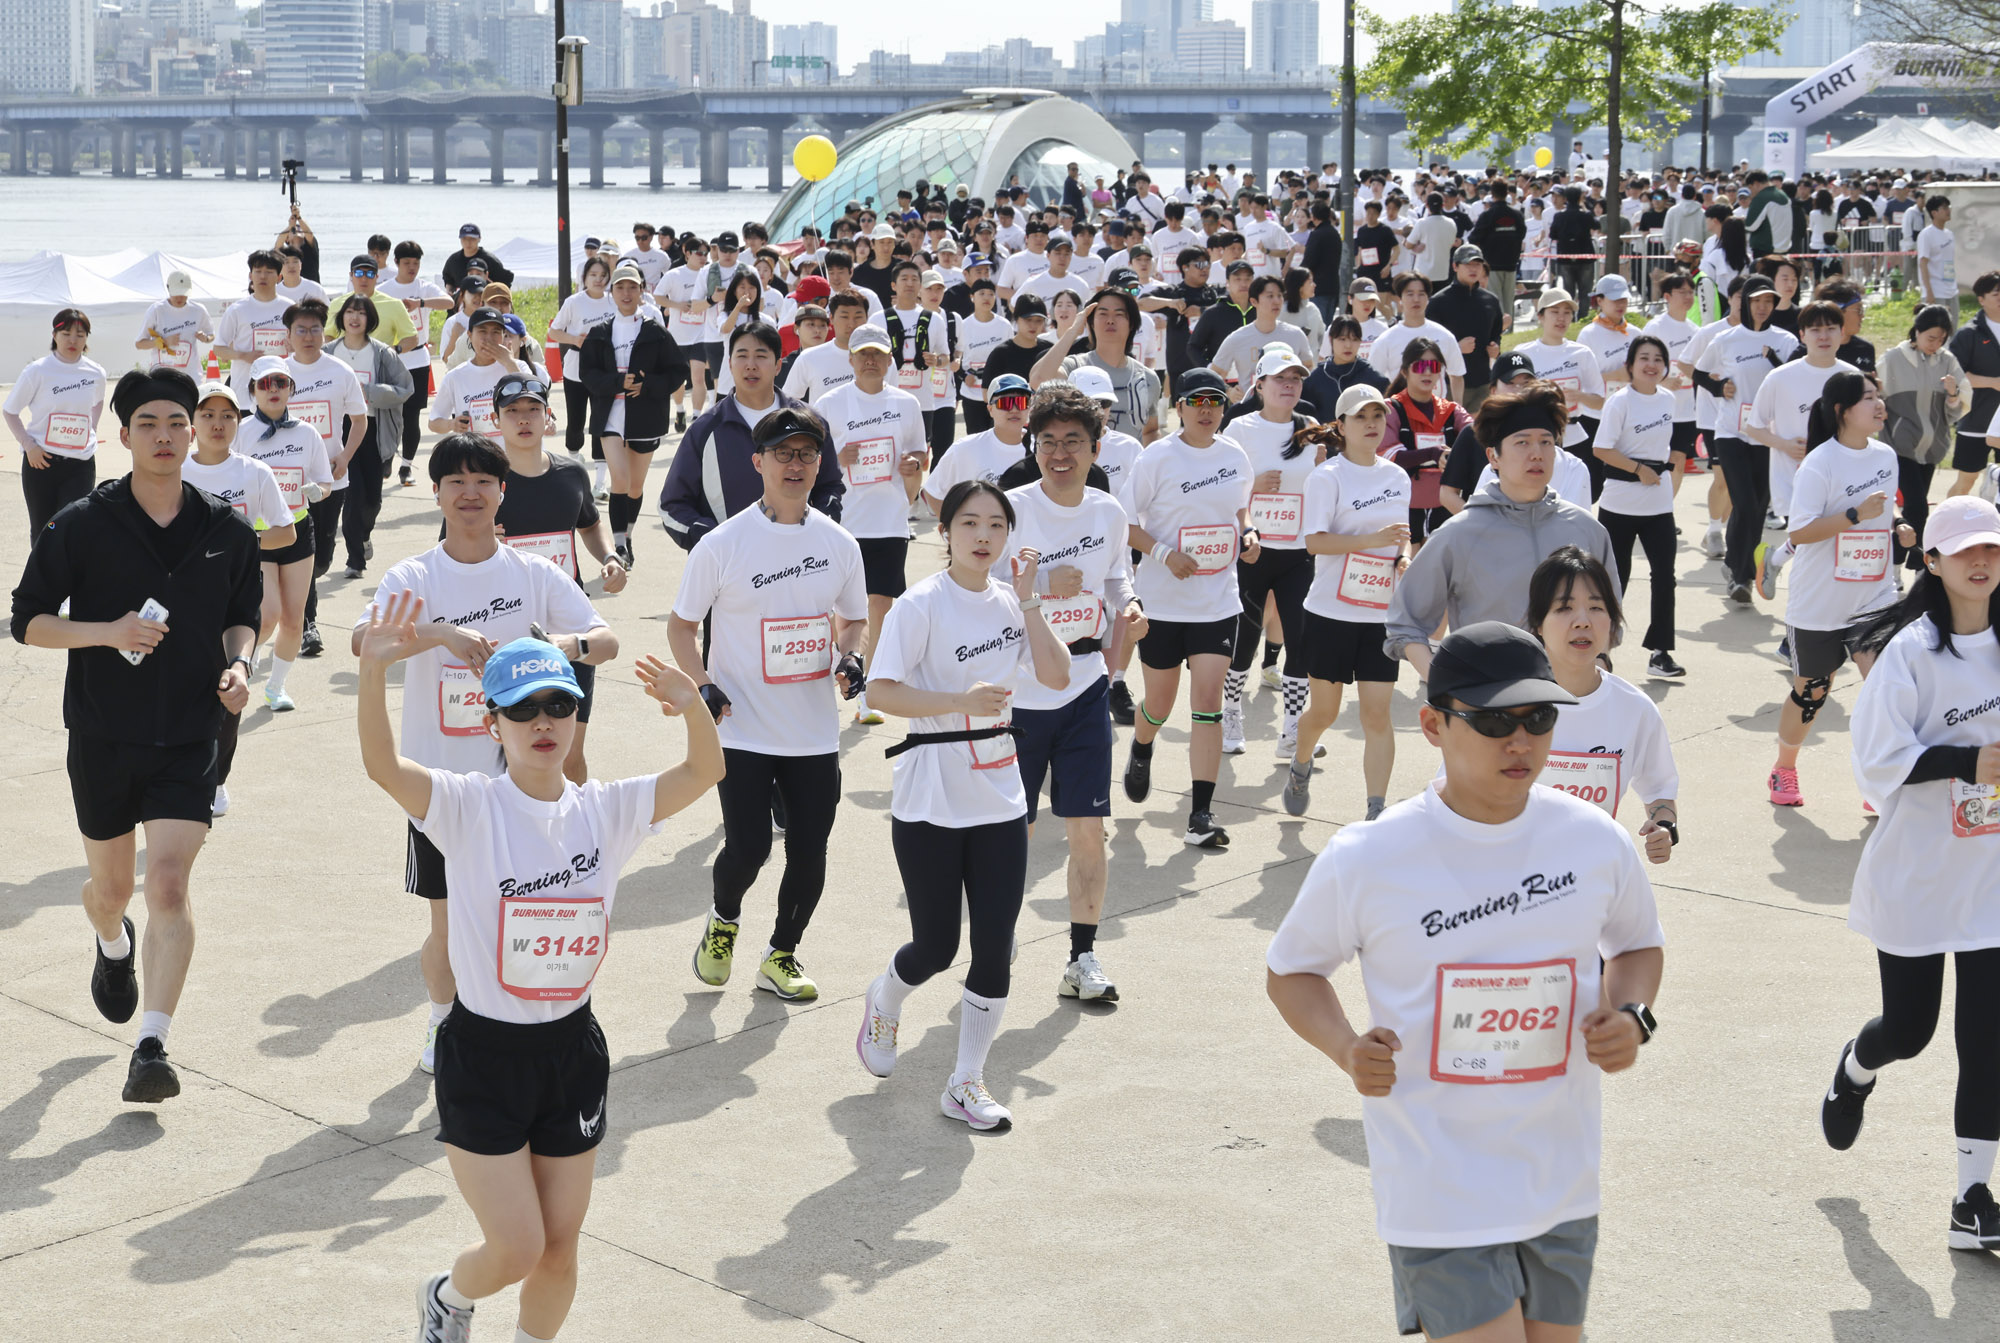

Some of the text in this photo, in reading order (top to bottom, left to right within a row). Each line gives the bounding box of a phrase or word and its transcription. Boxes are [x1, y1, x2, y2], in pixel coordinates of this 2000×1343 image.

[1790, 64, 1856, 114] START
[52, 378, 94, 394] Burning Run
[315, 379, 333, 389] Run
[822, 374, 854, 386] Burning
[847, 411, 902, 431] Burning Run
[1634, 418, 1663, 434] Burning
[60, 426, 84, 436] 3667
[284, 444, 304, 455] Run
[862, 453, 890, 466] 2351
[1102, 464, 1121, 474] Run
[1180, 468, 1238, 494] Burning Run
[1845, 469, 1892, 496] Burning Run
[221, 489, 245, 500] Run
[1352, 489, 1402, 510] Burning Run
[1265, 510, 1296, 520] 1156
[1079, 536, 1105, 552] Run
[1195, 544, 1229, 556] 3638
[1852, 548, 1884, 560] 3099
[752, 556, 830, 588] Burning Run
[1349, 572, 1391, 588] W 3246
[490, 598, 522, 614] Run
[1051, 608, 1094, 624] 2392
[768, 624, 796, 632] BURNING
[772, 638, 826, 656] M 2393
[955, 637, 1003, 662] Burning
[512, 658, 564, 680] HOKA
[449, 694, 460, 704] M
[1570, 762, 1588, 770] RUN
[512, 908, 554, 918] BURNING
[556, 910, 578, 918] RUN
[1420, 872, 1577, 938] Burning Run
[512, 936, 600, 956] W 3142
[1452, 978, 1504, 988] BURNING
[1506, 976, 1532, 987] RUN
[1452, 1006, 1560, 1033] M 2062
[1452, 1057, 1487, 1069] C-68
